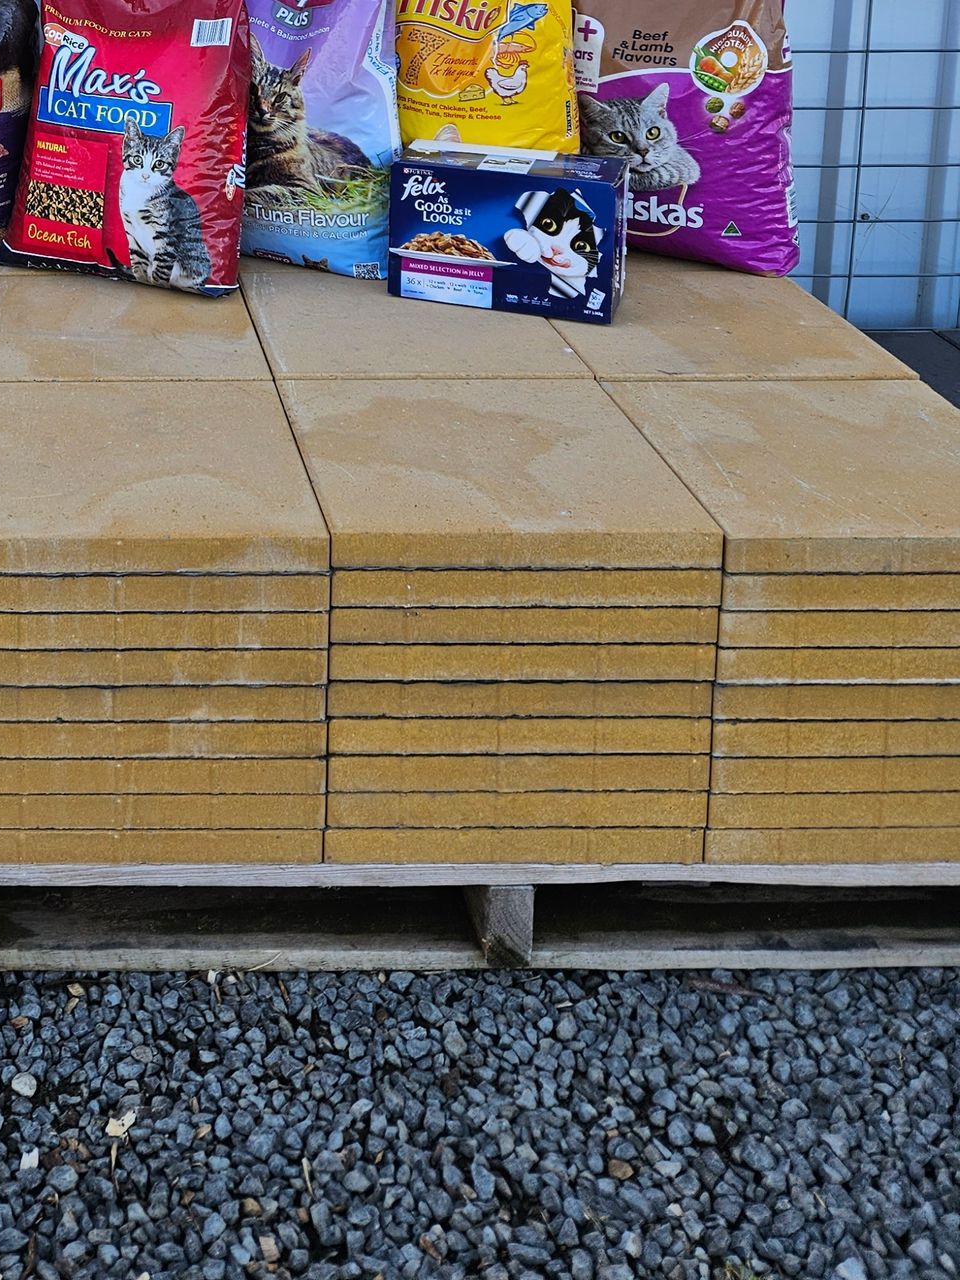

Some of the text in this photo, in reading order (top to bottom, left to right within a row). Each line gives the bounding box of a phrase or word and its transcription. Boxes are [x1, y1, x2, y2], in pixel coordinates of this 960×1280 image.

[44, 4, 153, 38] PREMIUM FOOD FOR CATS
[248, 16, 270, 29] plete
[276, 7, 309, 27] PLUS
[632, 29, 669, 41] Beef
[727, 29, 754, 47] QUALITY
[574, 49, 594, 61] ars
[620, 40, 674, 53] & Lamb
[611, 47, 677, 67] Flavours
[47, 45, 161, 113] Max's
[442, 66, 456, 78] the
[54, 98, 157, 128] CAT FOOD
[402, 103, 425, 115] Salmon,
[425, 110, 442, 118] Tuna,
[443, 111, 467, 120] Shrimp
[407, 97, 430, 109] Flavours
[439, 104, 468, 113] Chicken,
[469, 106, 488, 114] Beef,
[36, 140, 68, 154] NATURAL
[400, 174, 446, 201] felix
[414, 199, 452, 214] GOOD
[464, 207, 472, 216] it
[437, 195, 449, 204] As
[250, 202, 294, 225] Tuna
[298, 209, 370, 227] Flavour
[423, 210, 463, 226] LOOKS
[625, 192, 704, 229] iskas
[28, 223, 92, 249] Ocean Fish
[268, 225, 310, 237] PROTEIN
[321, 230, 368, 240] CALCIUM
[409, 262, 429, 271] MIXED
[429, 265, 461, 274] SELECTION
[468, 269, 485, 277] JELLY
[406, 277, 416, 285] 36
